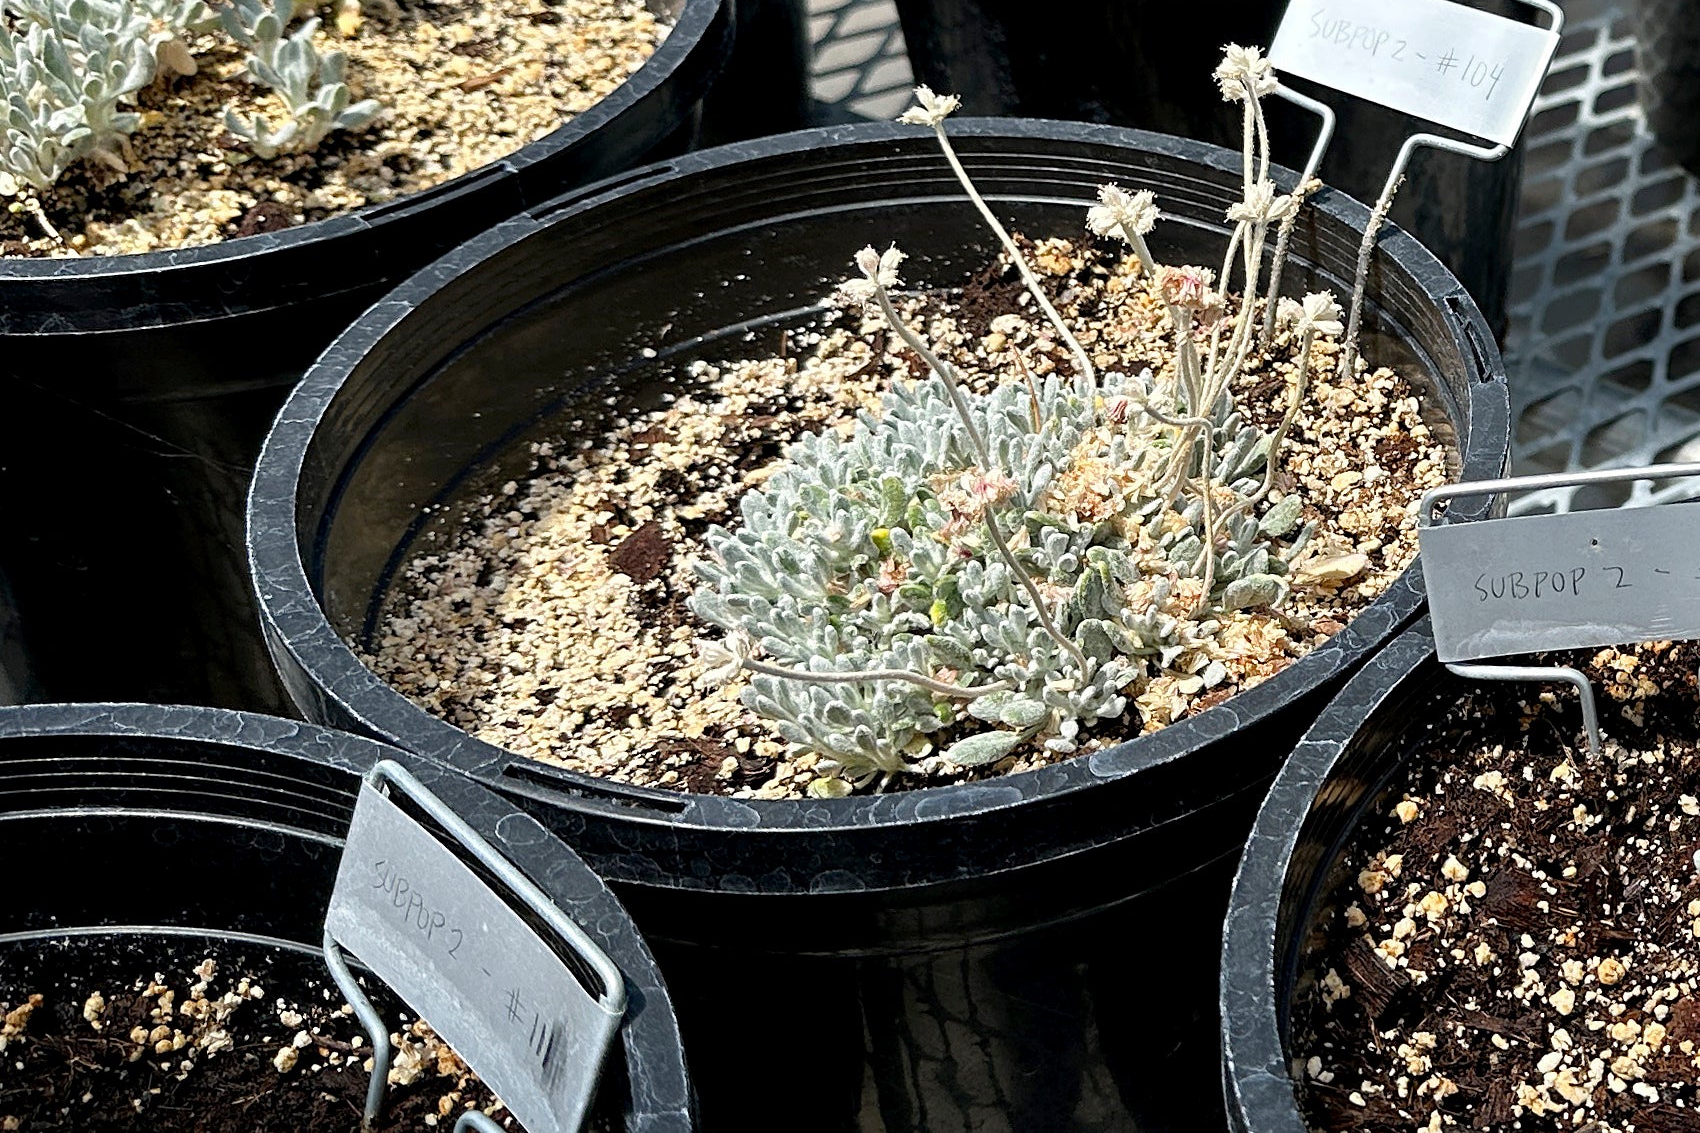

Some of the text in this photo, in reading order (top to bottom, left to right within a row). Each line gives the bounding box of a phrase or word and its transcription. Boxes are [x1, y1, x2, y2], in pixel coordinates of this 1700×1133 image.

[1308, 8, 1390, 58] SUBPOP
[1391, 39, 1409, 63] 2
[1436, 46, 1506, 102] #104
[1474, 565, 1587, 603] SUBPOP
[1602, 566, 1634, 589] 2
[372, 859, 447, 941] SUBPOP
[448, 928, 464, 962] 2
